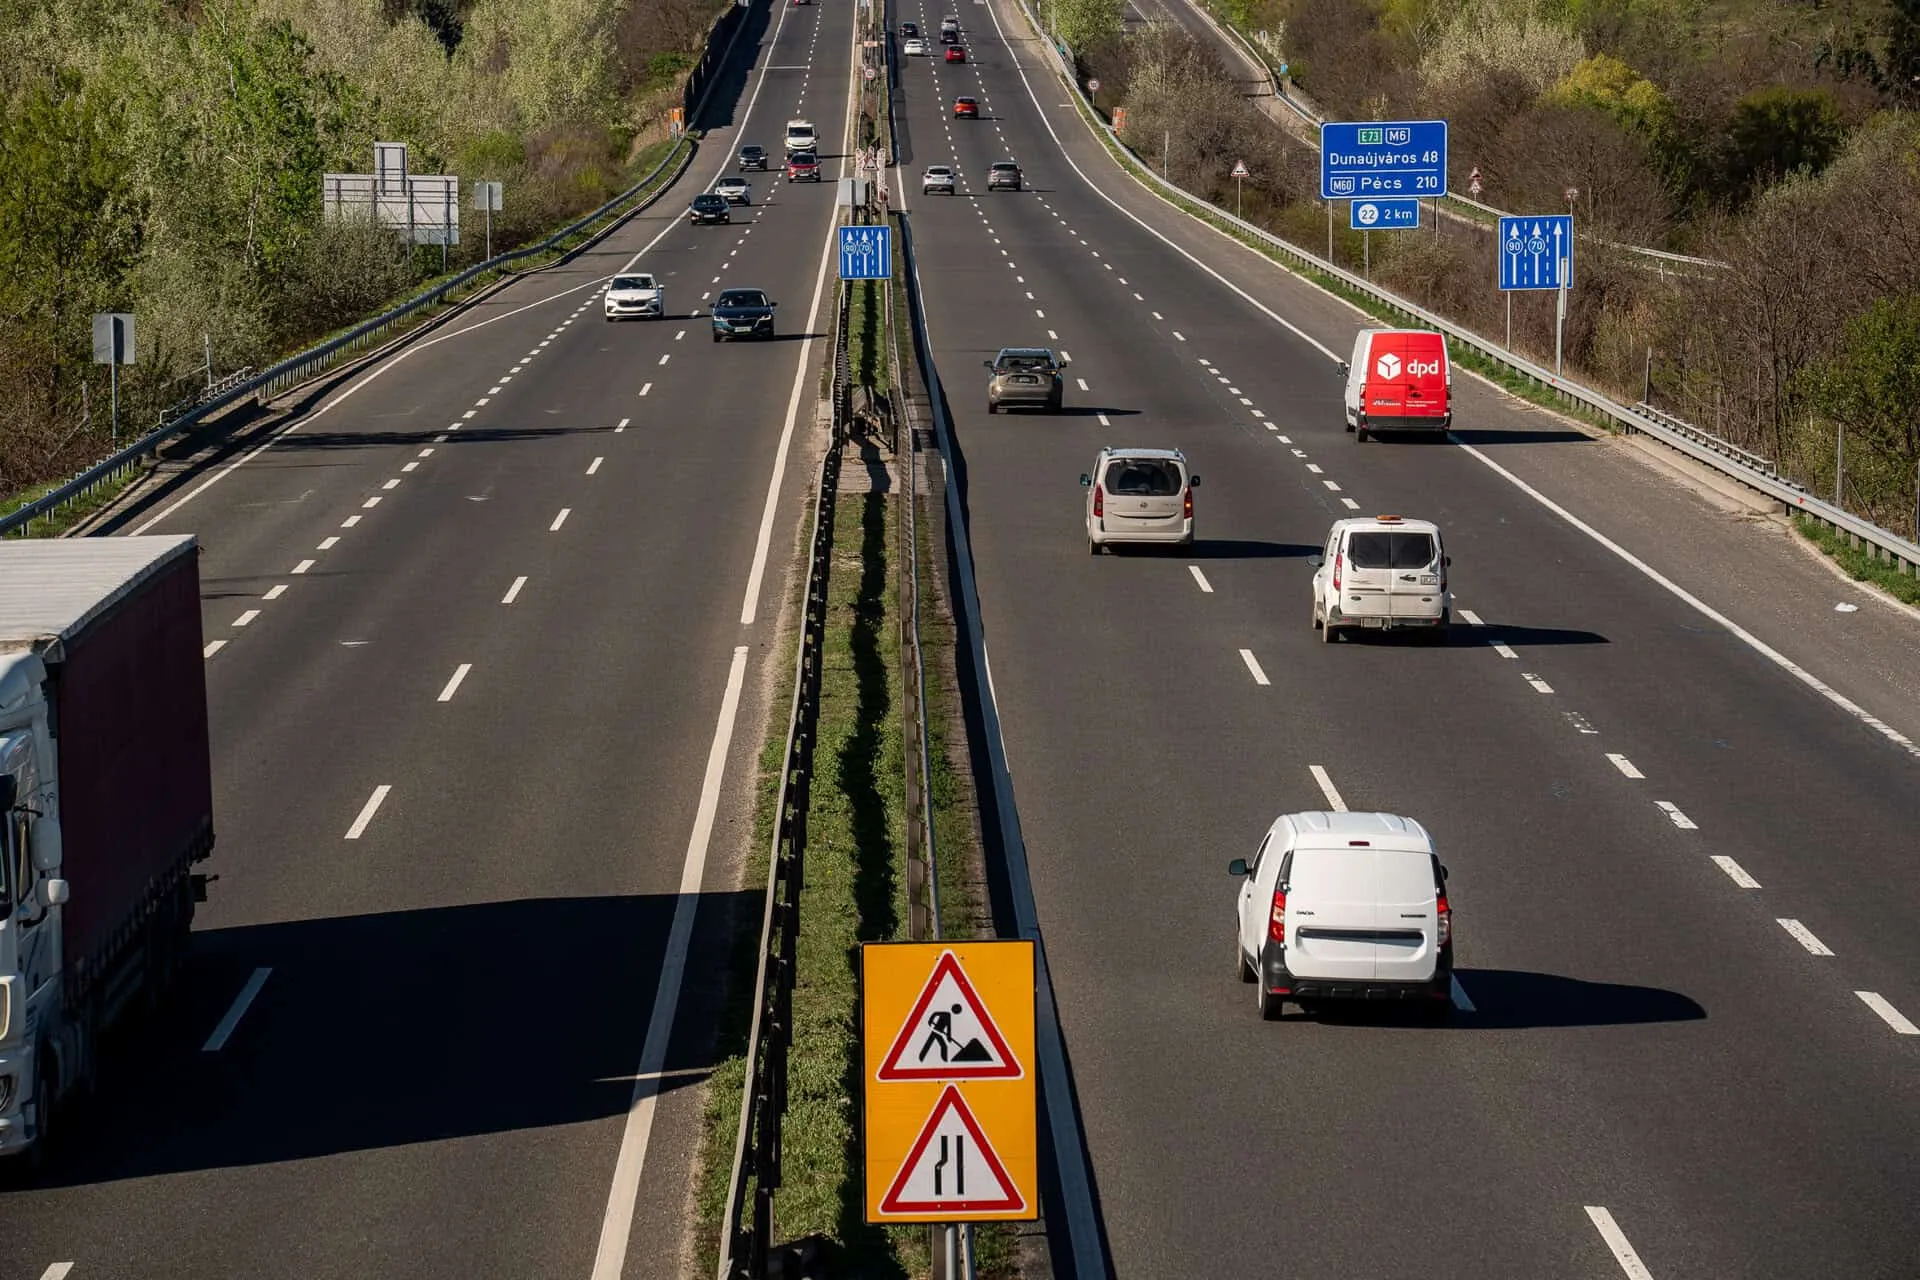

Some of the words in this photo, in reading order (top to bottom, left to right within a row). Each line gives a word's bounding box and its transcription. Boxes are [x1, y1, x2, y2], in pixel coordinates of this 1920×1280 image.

[1361, 131, 1379, 142] E73
[1389, 130, 1406, 141] M6
[1330, 152, 1417, 166] Dunaújváros
[1422, 151, 1438, 163] 48
[1333, 180, 1352, 191] M60
[1361, 176, 1402, 190] Pécs
[1416, 176, 1437, 189] 210
[1361, 209, 1375, 220] 22
[1384, 209, 1391, 219] 2
[1394, 208, 1412, 219] km
[1508, 242, 1521, 251] 90
[1531, 242, 1543, 251] 70
[1407, 359, 1439, 379] dpd
